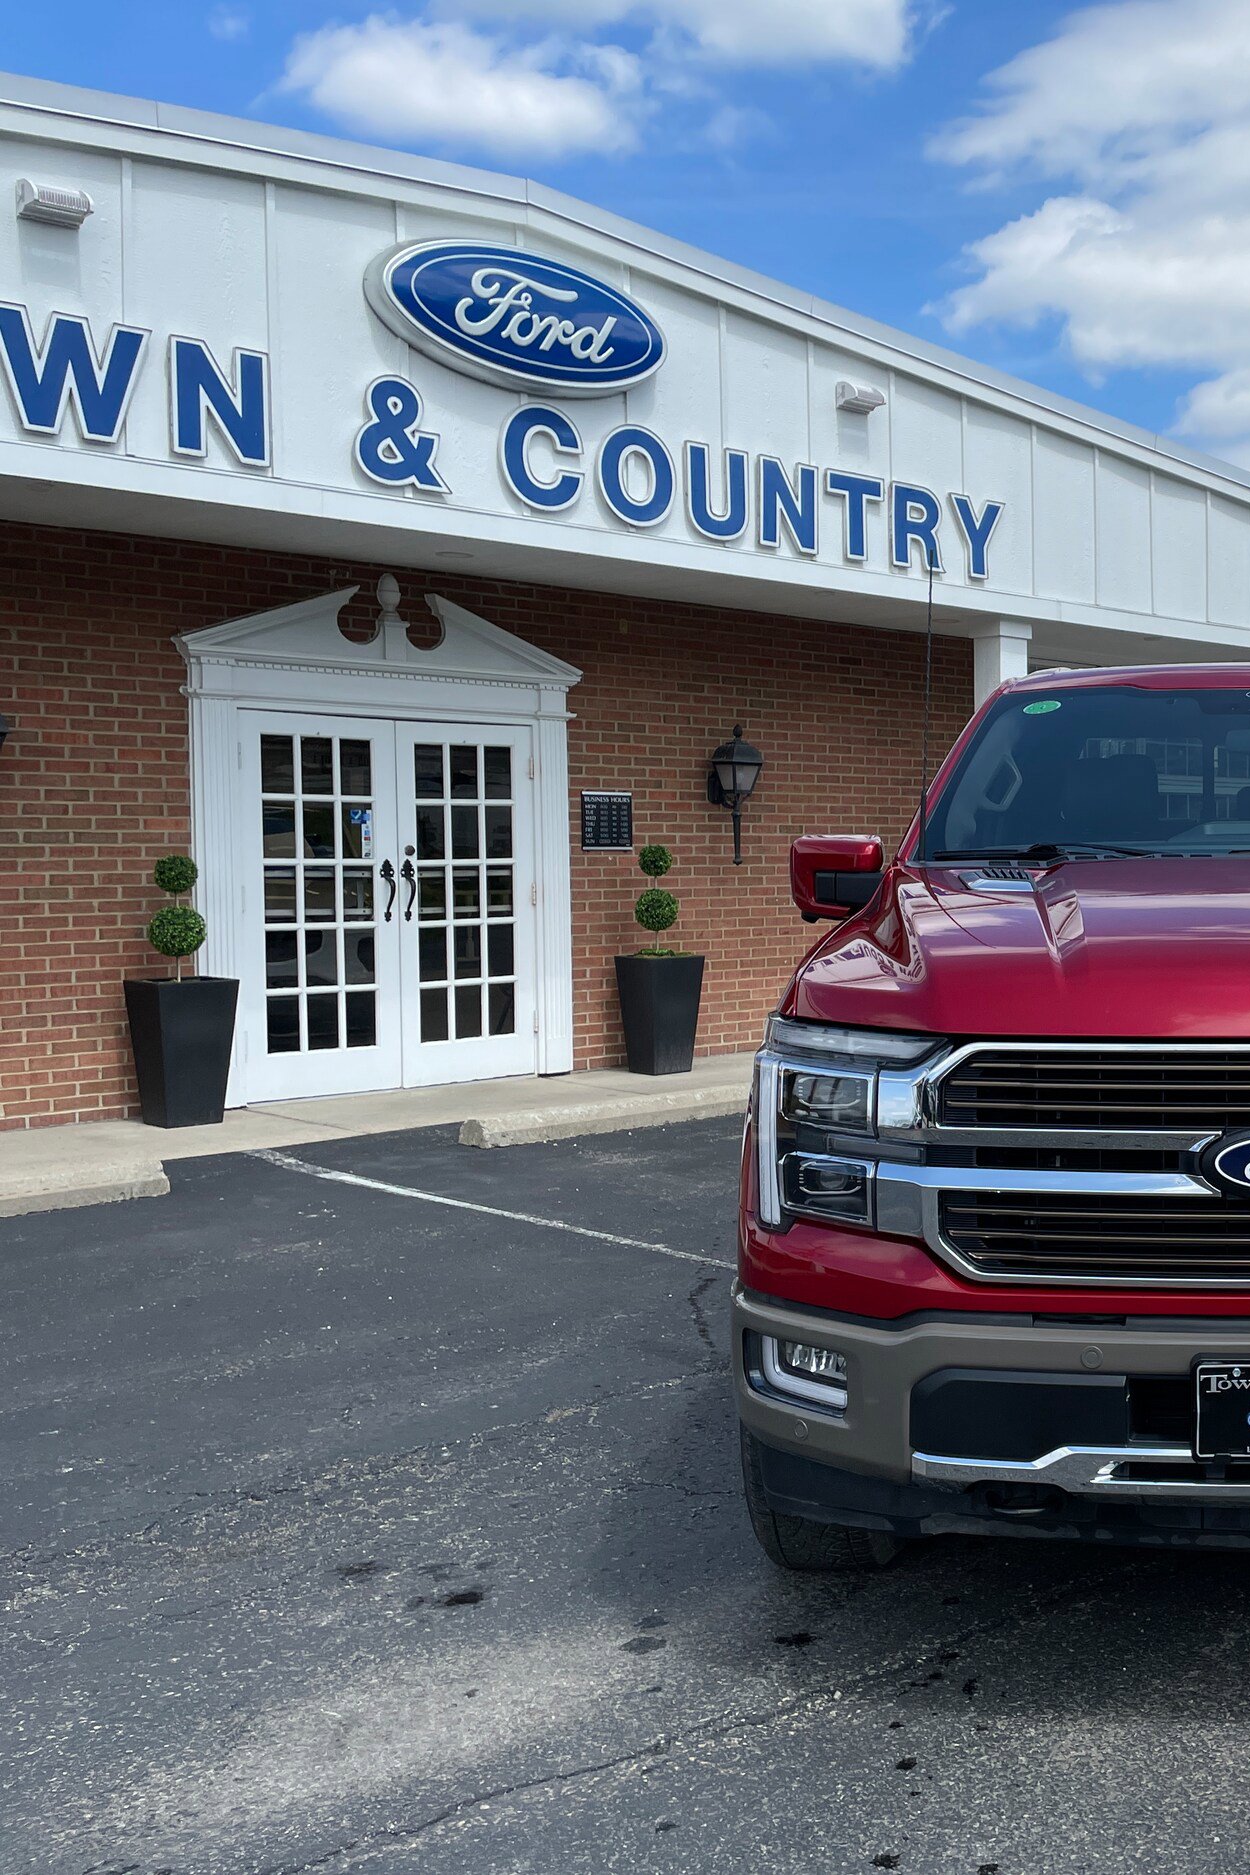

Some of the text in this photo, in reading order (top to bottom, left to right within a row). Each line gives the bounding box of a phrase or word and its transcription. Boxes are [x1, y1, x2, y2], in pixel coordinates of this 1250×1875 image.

[454, 267, 618, 364] Ford
[354, 374, 453, 495] &
[500, 402, 1006, 580] COUNTRY
